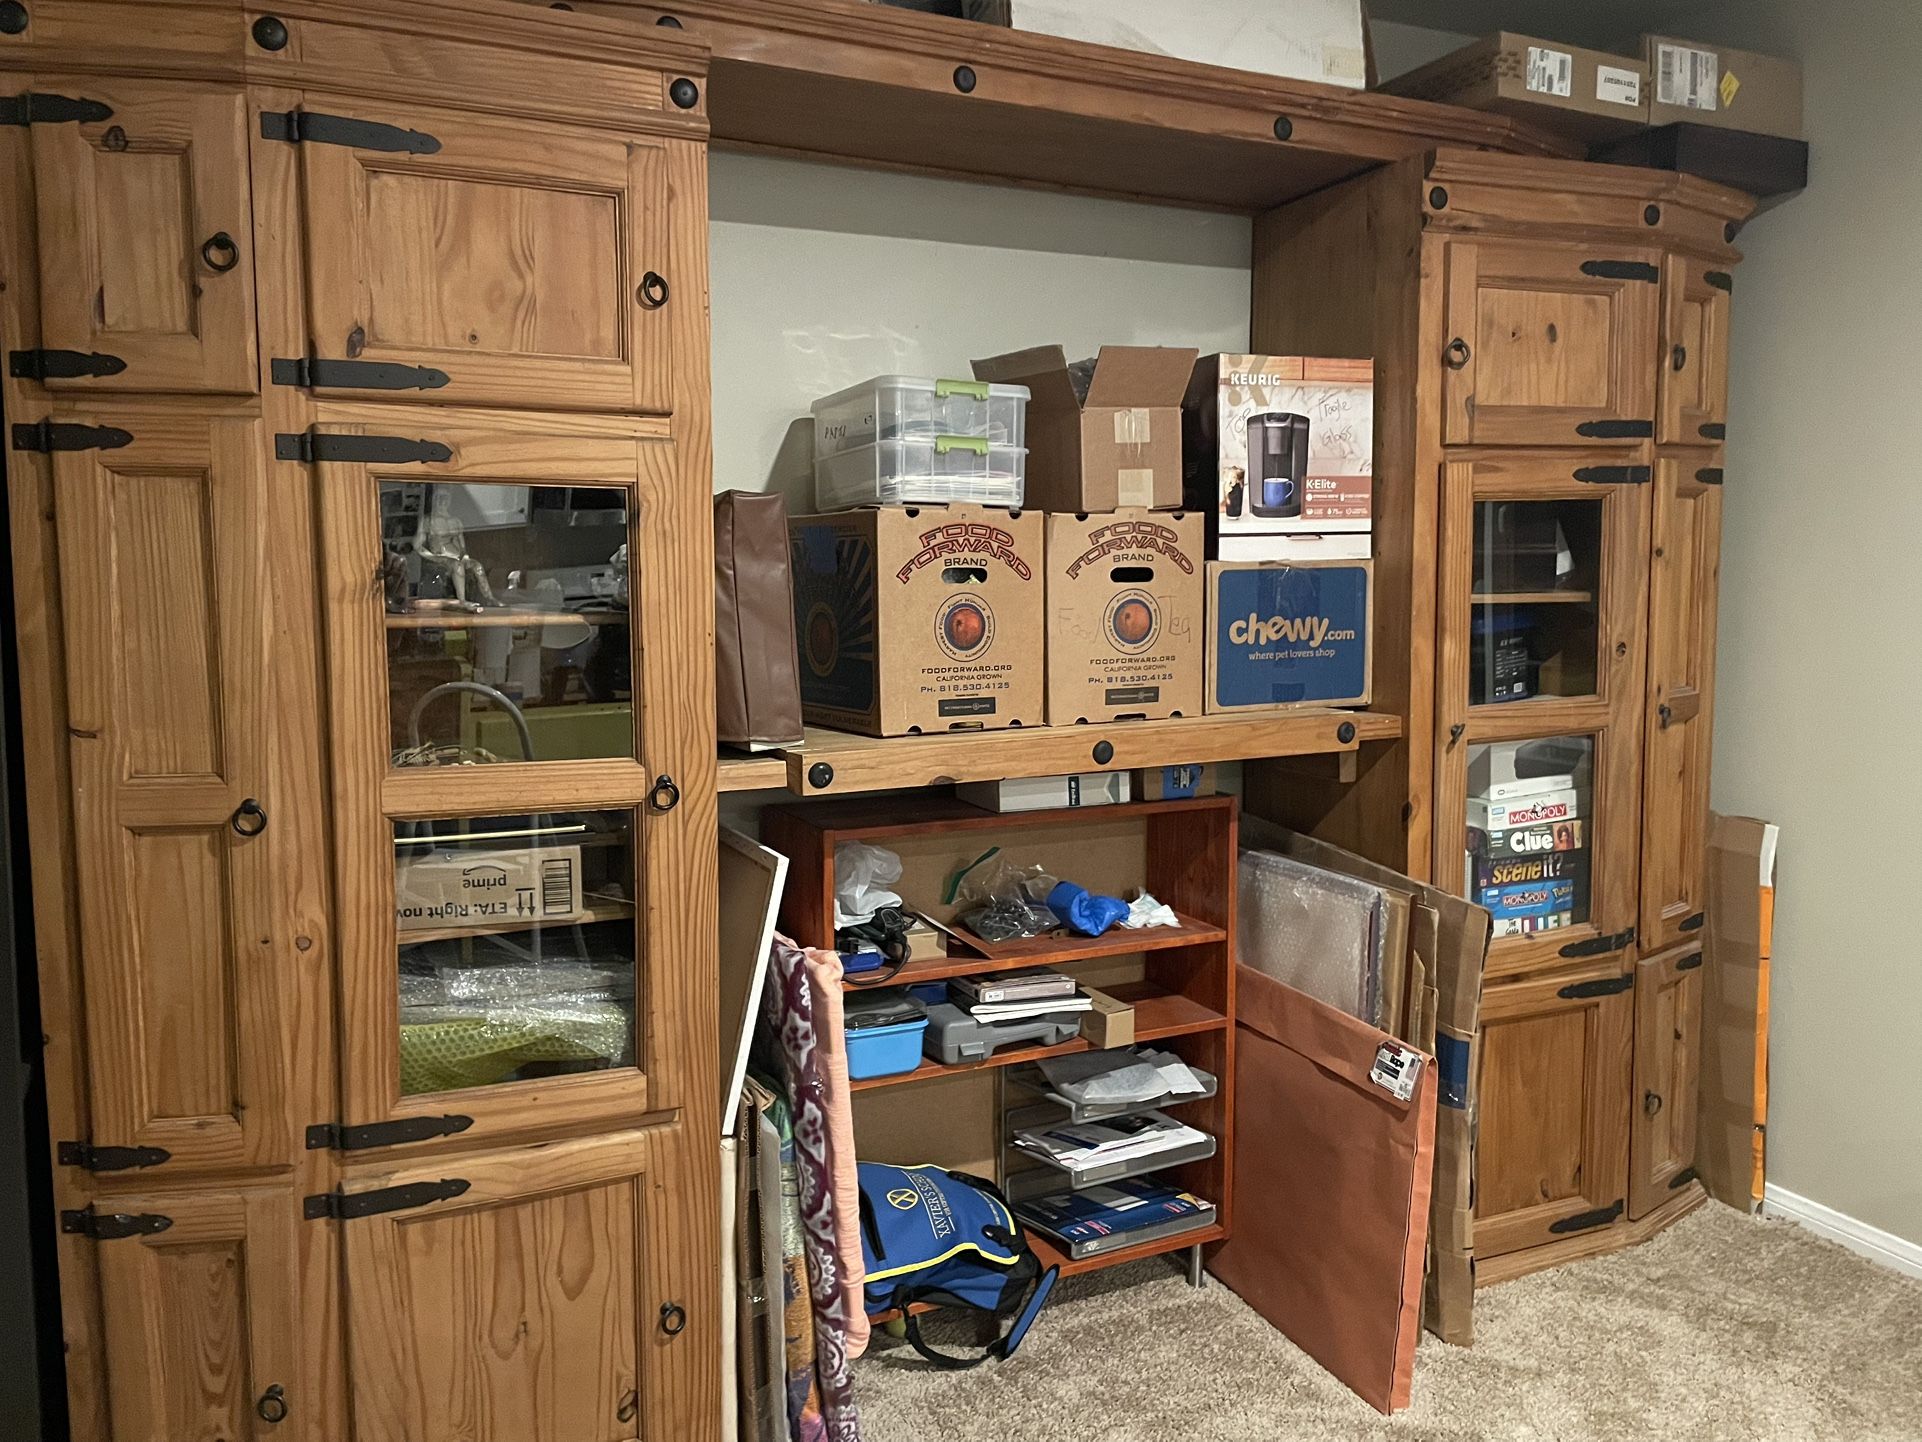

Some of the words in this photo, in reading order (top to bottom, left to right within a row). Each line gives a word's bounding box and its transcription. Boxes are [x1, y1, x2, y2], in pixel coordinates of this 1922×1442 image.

[1231, 373, 1280, 385] KEURIG
[919, 523, 1014, 548] FOOD
[1088, 521, 1178, 545] FOOD
[896, 538, 1032, 584] FORWARD
[944, 557, 988, 567] BRAND
[1066, 535, 1194, 580] FORWARD
[1113, 553, 1155, 563] BRAND
[1228, 612, 1355, 648] chewy.com
[1089, 655, 1176, 665] FOODFORWARD.ORG
[1248, 651, 1275, 661] where
[1275, 651, 1289, 661] pet
[1289, 649, 1315, 659] lovers
[1315, 648, 1336, 659] shop
[921, 664, 1013, 675] FOODFORWARD.ORG
[1103, 665, 1142, 673] CALIFORNIA
[935, 674, 975, 683] CALIFORNIA
[976, 673, 1003, 682] GROWN
[939, 681, 1010, 692] 818.530.4125
[1510, 804, 1566, 824] MONOPOLY
[1509, 831, 1554, 853] Clue
[1492, 861, 1542, 885] scene
[1543, 853, 1564, 878] it?
[462, 874, 508, 891] prime
[1503, 891, 1548, 907] MONOPOLY
[427, 902, 469, 918] Right
[473, 901, 508, 915] ETA:
[924, 1190, 951, 1238] XAVIER'S
